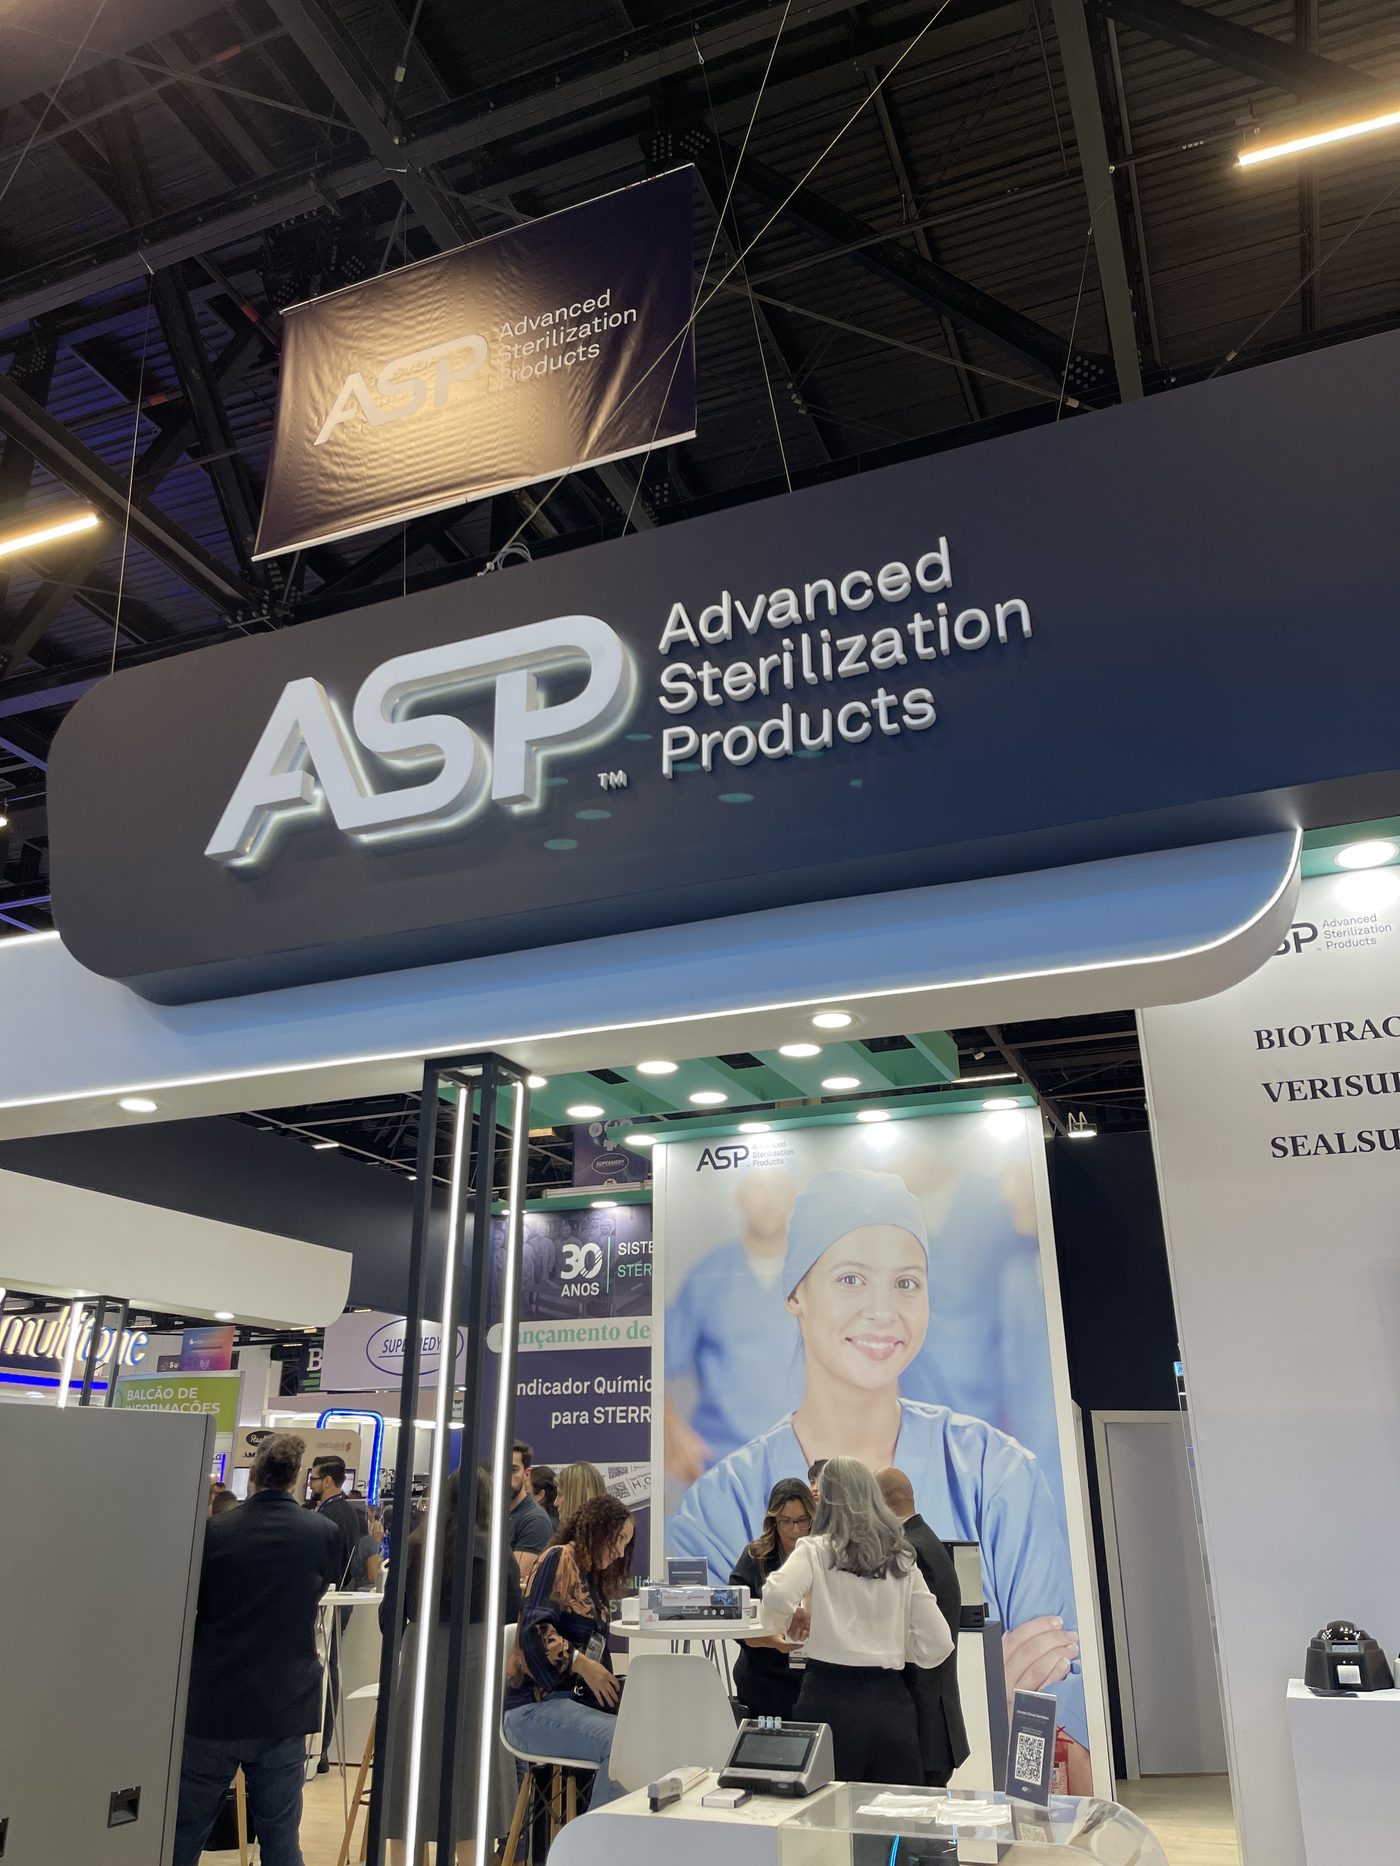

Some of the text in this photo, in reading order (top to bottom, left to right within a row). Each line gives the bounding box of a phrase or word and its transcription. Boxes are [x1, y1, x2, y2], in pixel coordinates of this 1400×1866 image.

[500, 289, 611, 338] Advanced
[500, 309, 637, 362] Sterilization
[500, 343, 600, 390] Products
[314, 334, 488, 446] ASP
[659, 536, 952, 655] Advanced
[659, 598, 1032, 714] Sterilization
[204, 615, 632, 862] ASP
[662, 687, 937, 779] Products
[1322, 913, 1377, 928] Advanced
[1323, 924, 1392, 939] Sterilization
[1326, 937, 1377, 950] Products
[1254, 1016, 1400, 1050] BIOTRAC
[696, 1145, 750, 1171] ASP
[1271, 1128, 1400, 1159] SEALSU
[752, 1159, 784, 1167] Products
[561, 1242, 603, 1280] 30
[561, 1282, 600, 1297] ANOS
[519, 1320, 650, 1349] nçamento de
[127, 1386, 198, 1401] BALCÃO DE
[516, 1377, 591, 1396] ndicador
[551, 1410, 590, 1429] para
